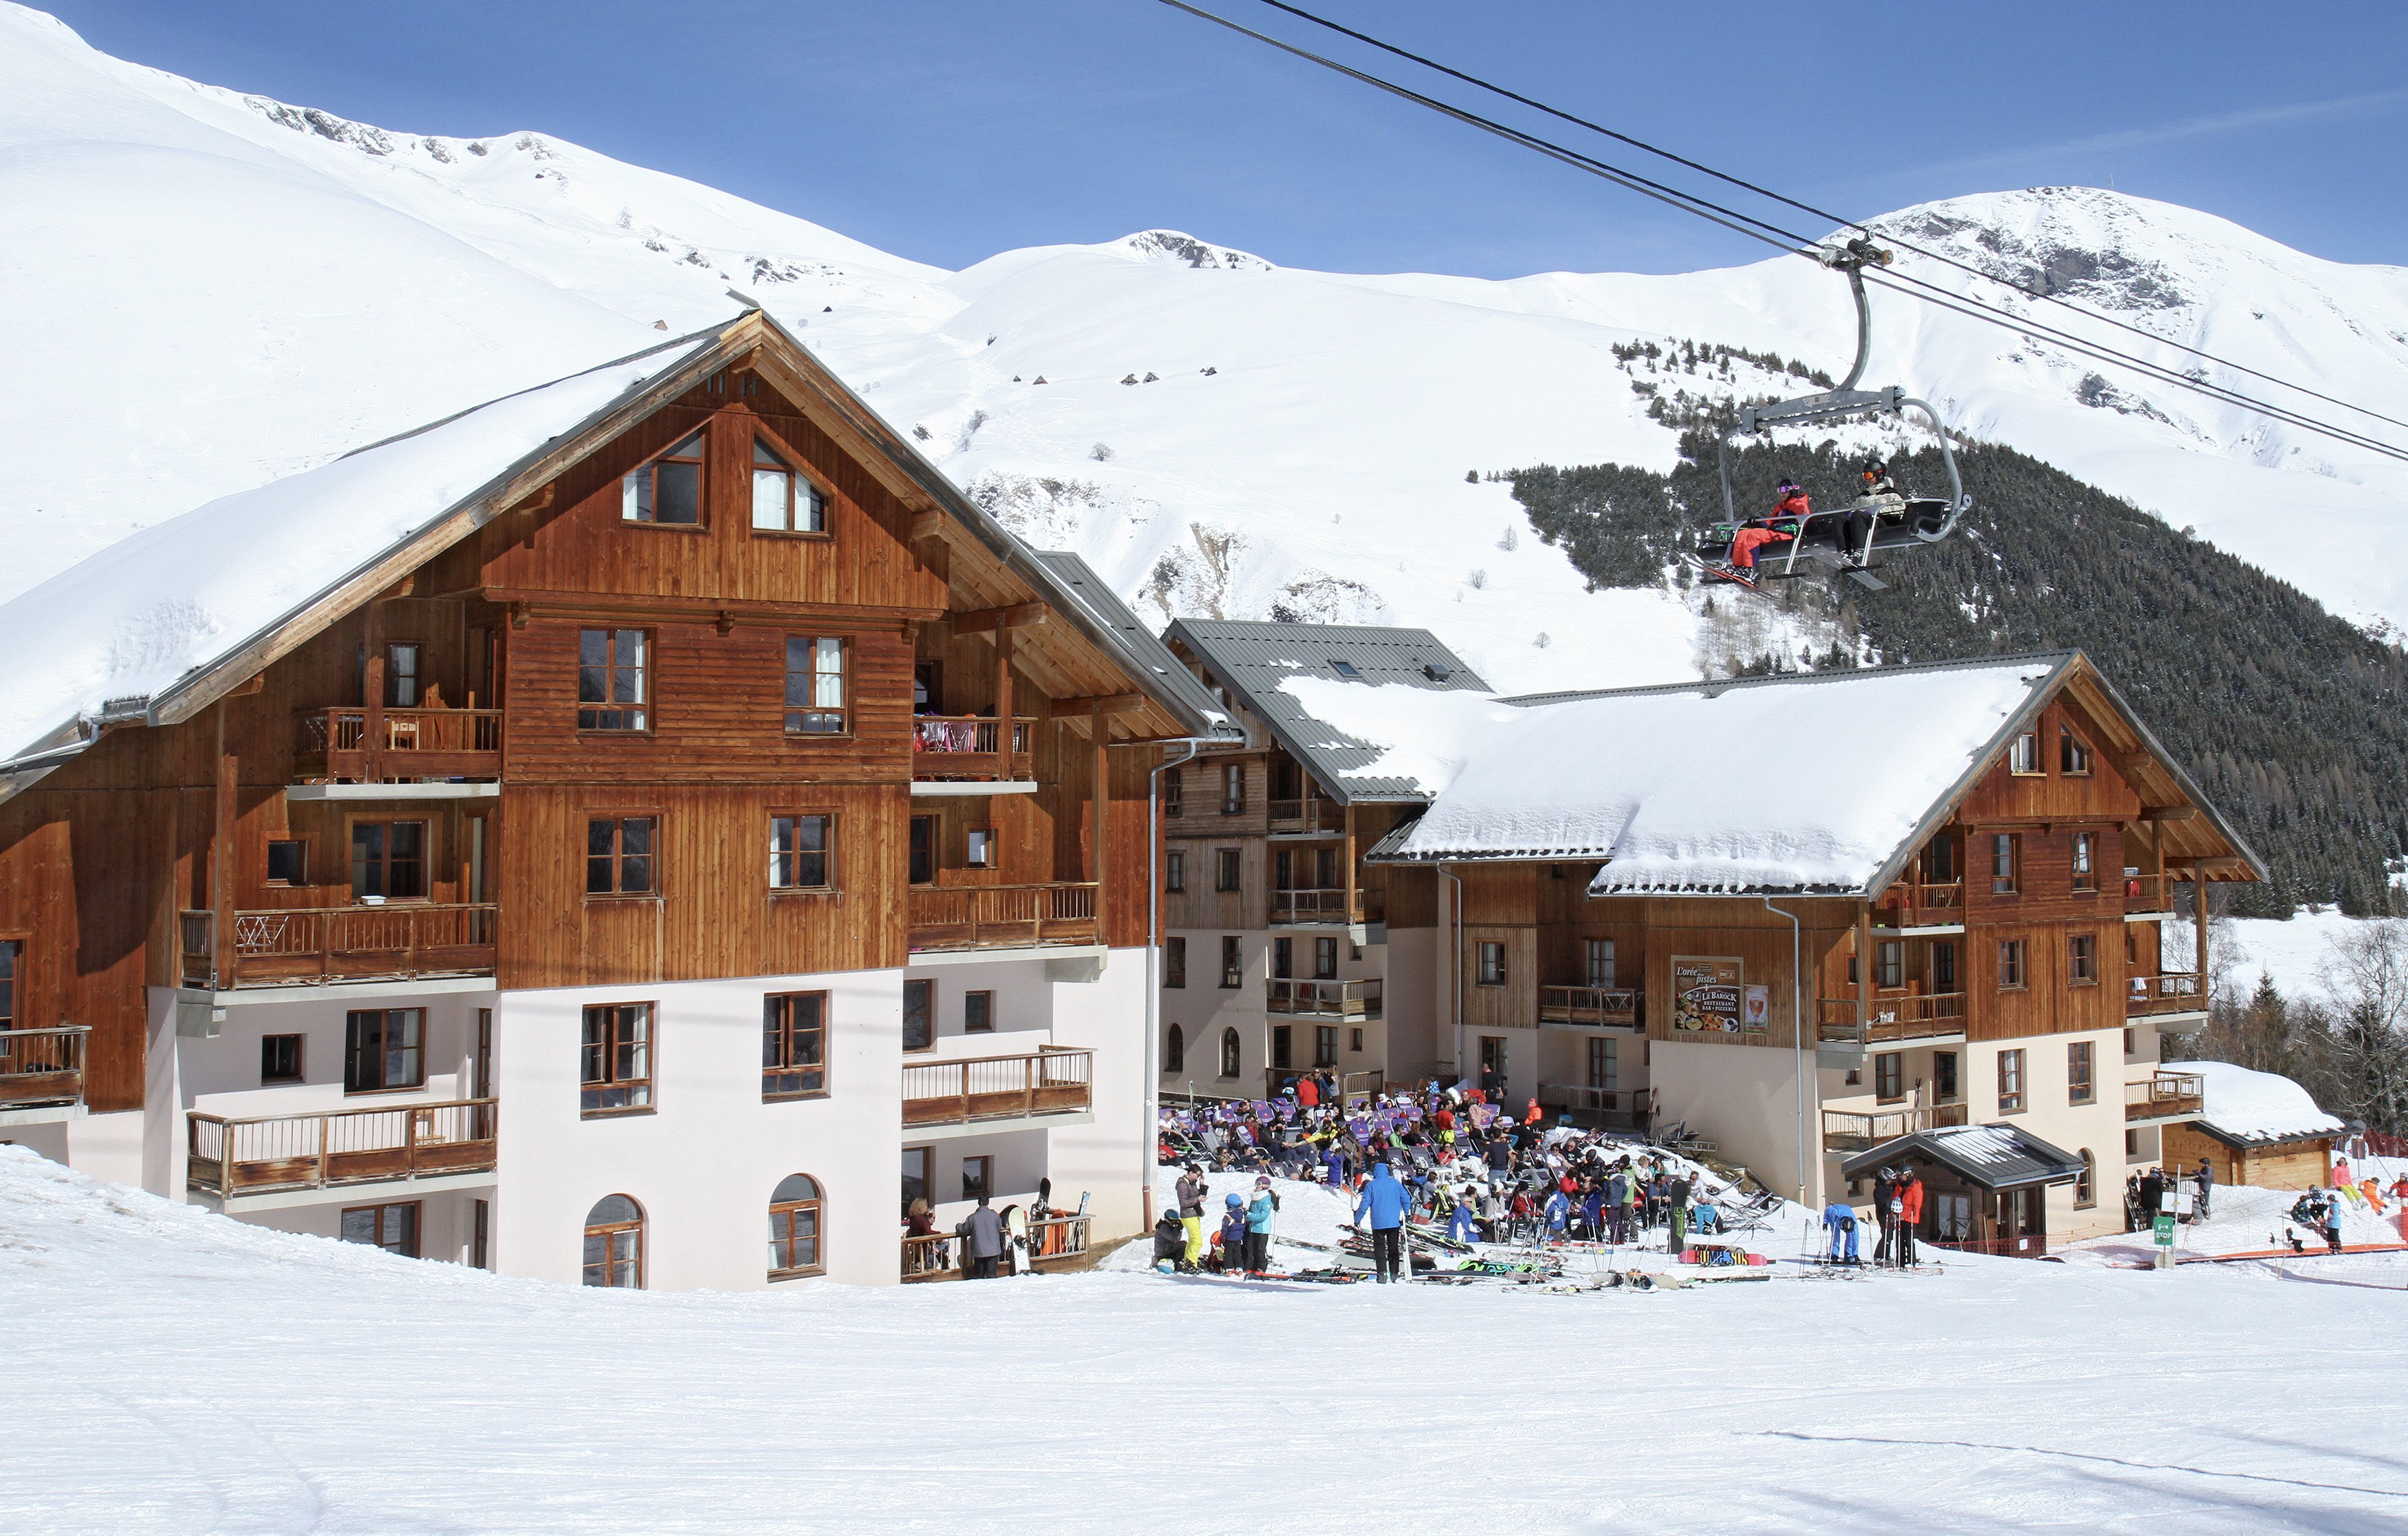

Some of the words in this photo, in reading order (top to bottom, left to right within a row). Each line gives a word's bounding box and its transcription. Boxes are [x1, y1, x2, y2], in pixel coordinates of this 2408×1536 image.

[1676, 967, 1697, 976] L'orée
[1696, 975, 1717, 984] pistes
[1711, 991, 1737, 1002] BAROCK
